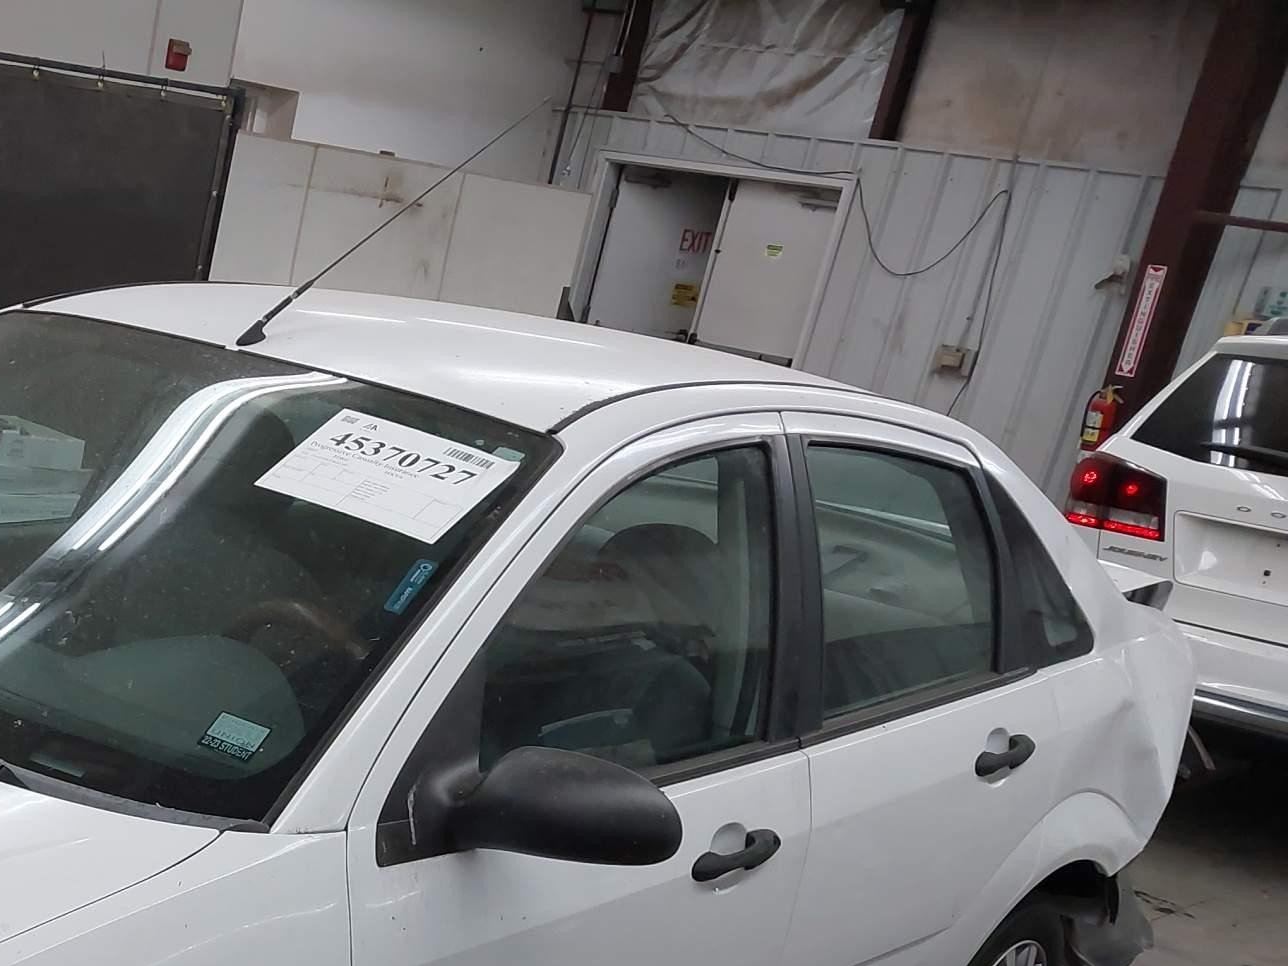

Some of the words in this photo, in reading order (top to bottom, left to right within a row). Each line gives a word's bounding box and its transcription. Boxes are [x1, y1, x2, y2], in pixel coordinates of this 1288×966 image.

[679, 229, 712, 254] EXIT
[329, 432, 478, 485] 45370727
[219, 742, 253, 760] STUDENT
